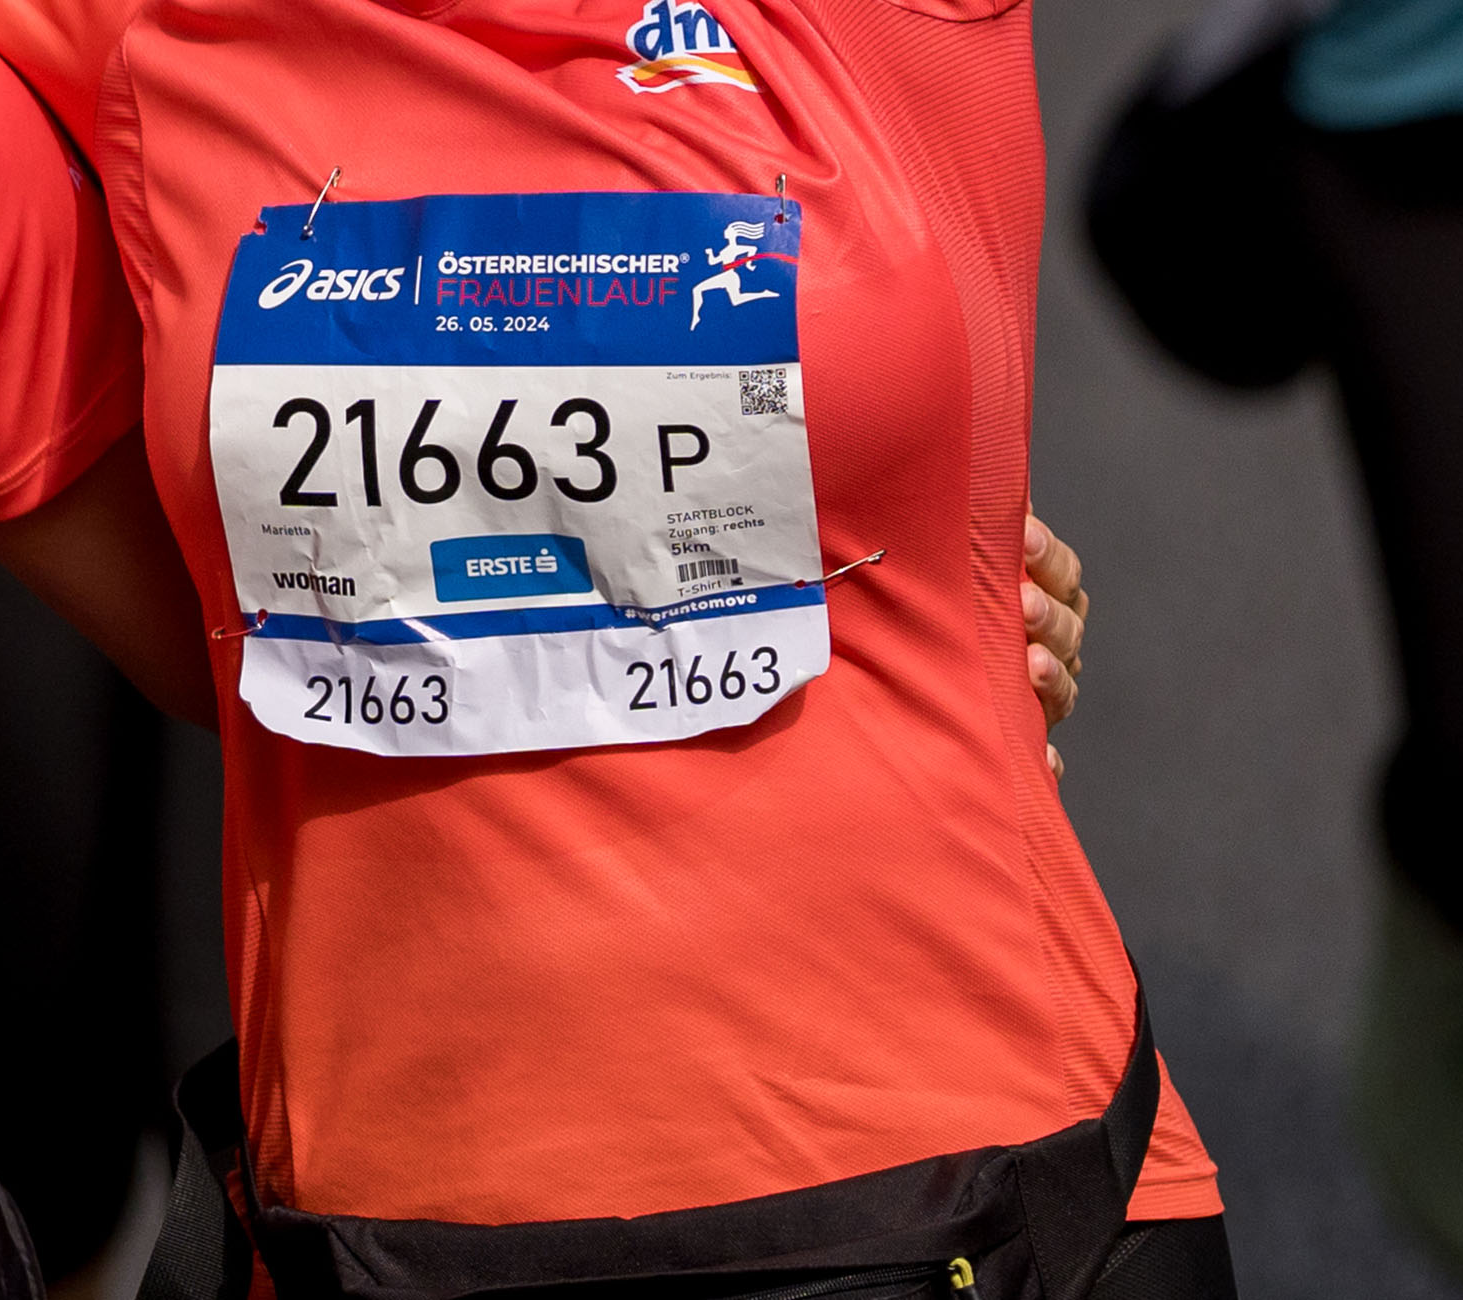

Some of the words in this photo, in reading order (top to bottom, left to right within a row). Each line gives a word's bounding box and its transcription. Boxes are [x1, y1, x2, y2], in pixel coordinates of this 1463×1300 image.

[435, 277, 679, 307] FRAUENLAUF
[436, 316, 463, 332] 26.
[469, 316, 498, 332] 05.
[503, 316, 551, 332] 2024
[666, 371, 687, 380] Zum
[272, 397, 618, 507] 21663
[657, 424, 711, 493] P
[667, 505, 755, 525] STARTBLOCK
[261, 523, 311, 537] Marietta
[668, 524, 720, 539] Zugang:
[723, 517, 765, 532] rechts
[671, 542, 711, 556] 5km
[466, 556, 533, 578] ERSTE
[272, 571, 356, 597] woman
[677, 579, 722, 598] T-Shirt
[625, 646, 782, 712] 21663
[303, 675, 450, 725] 21663
